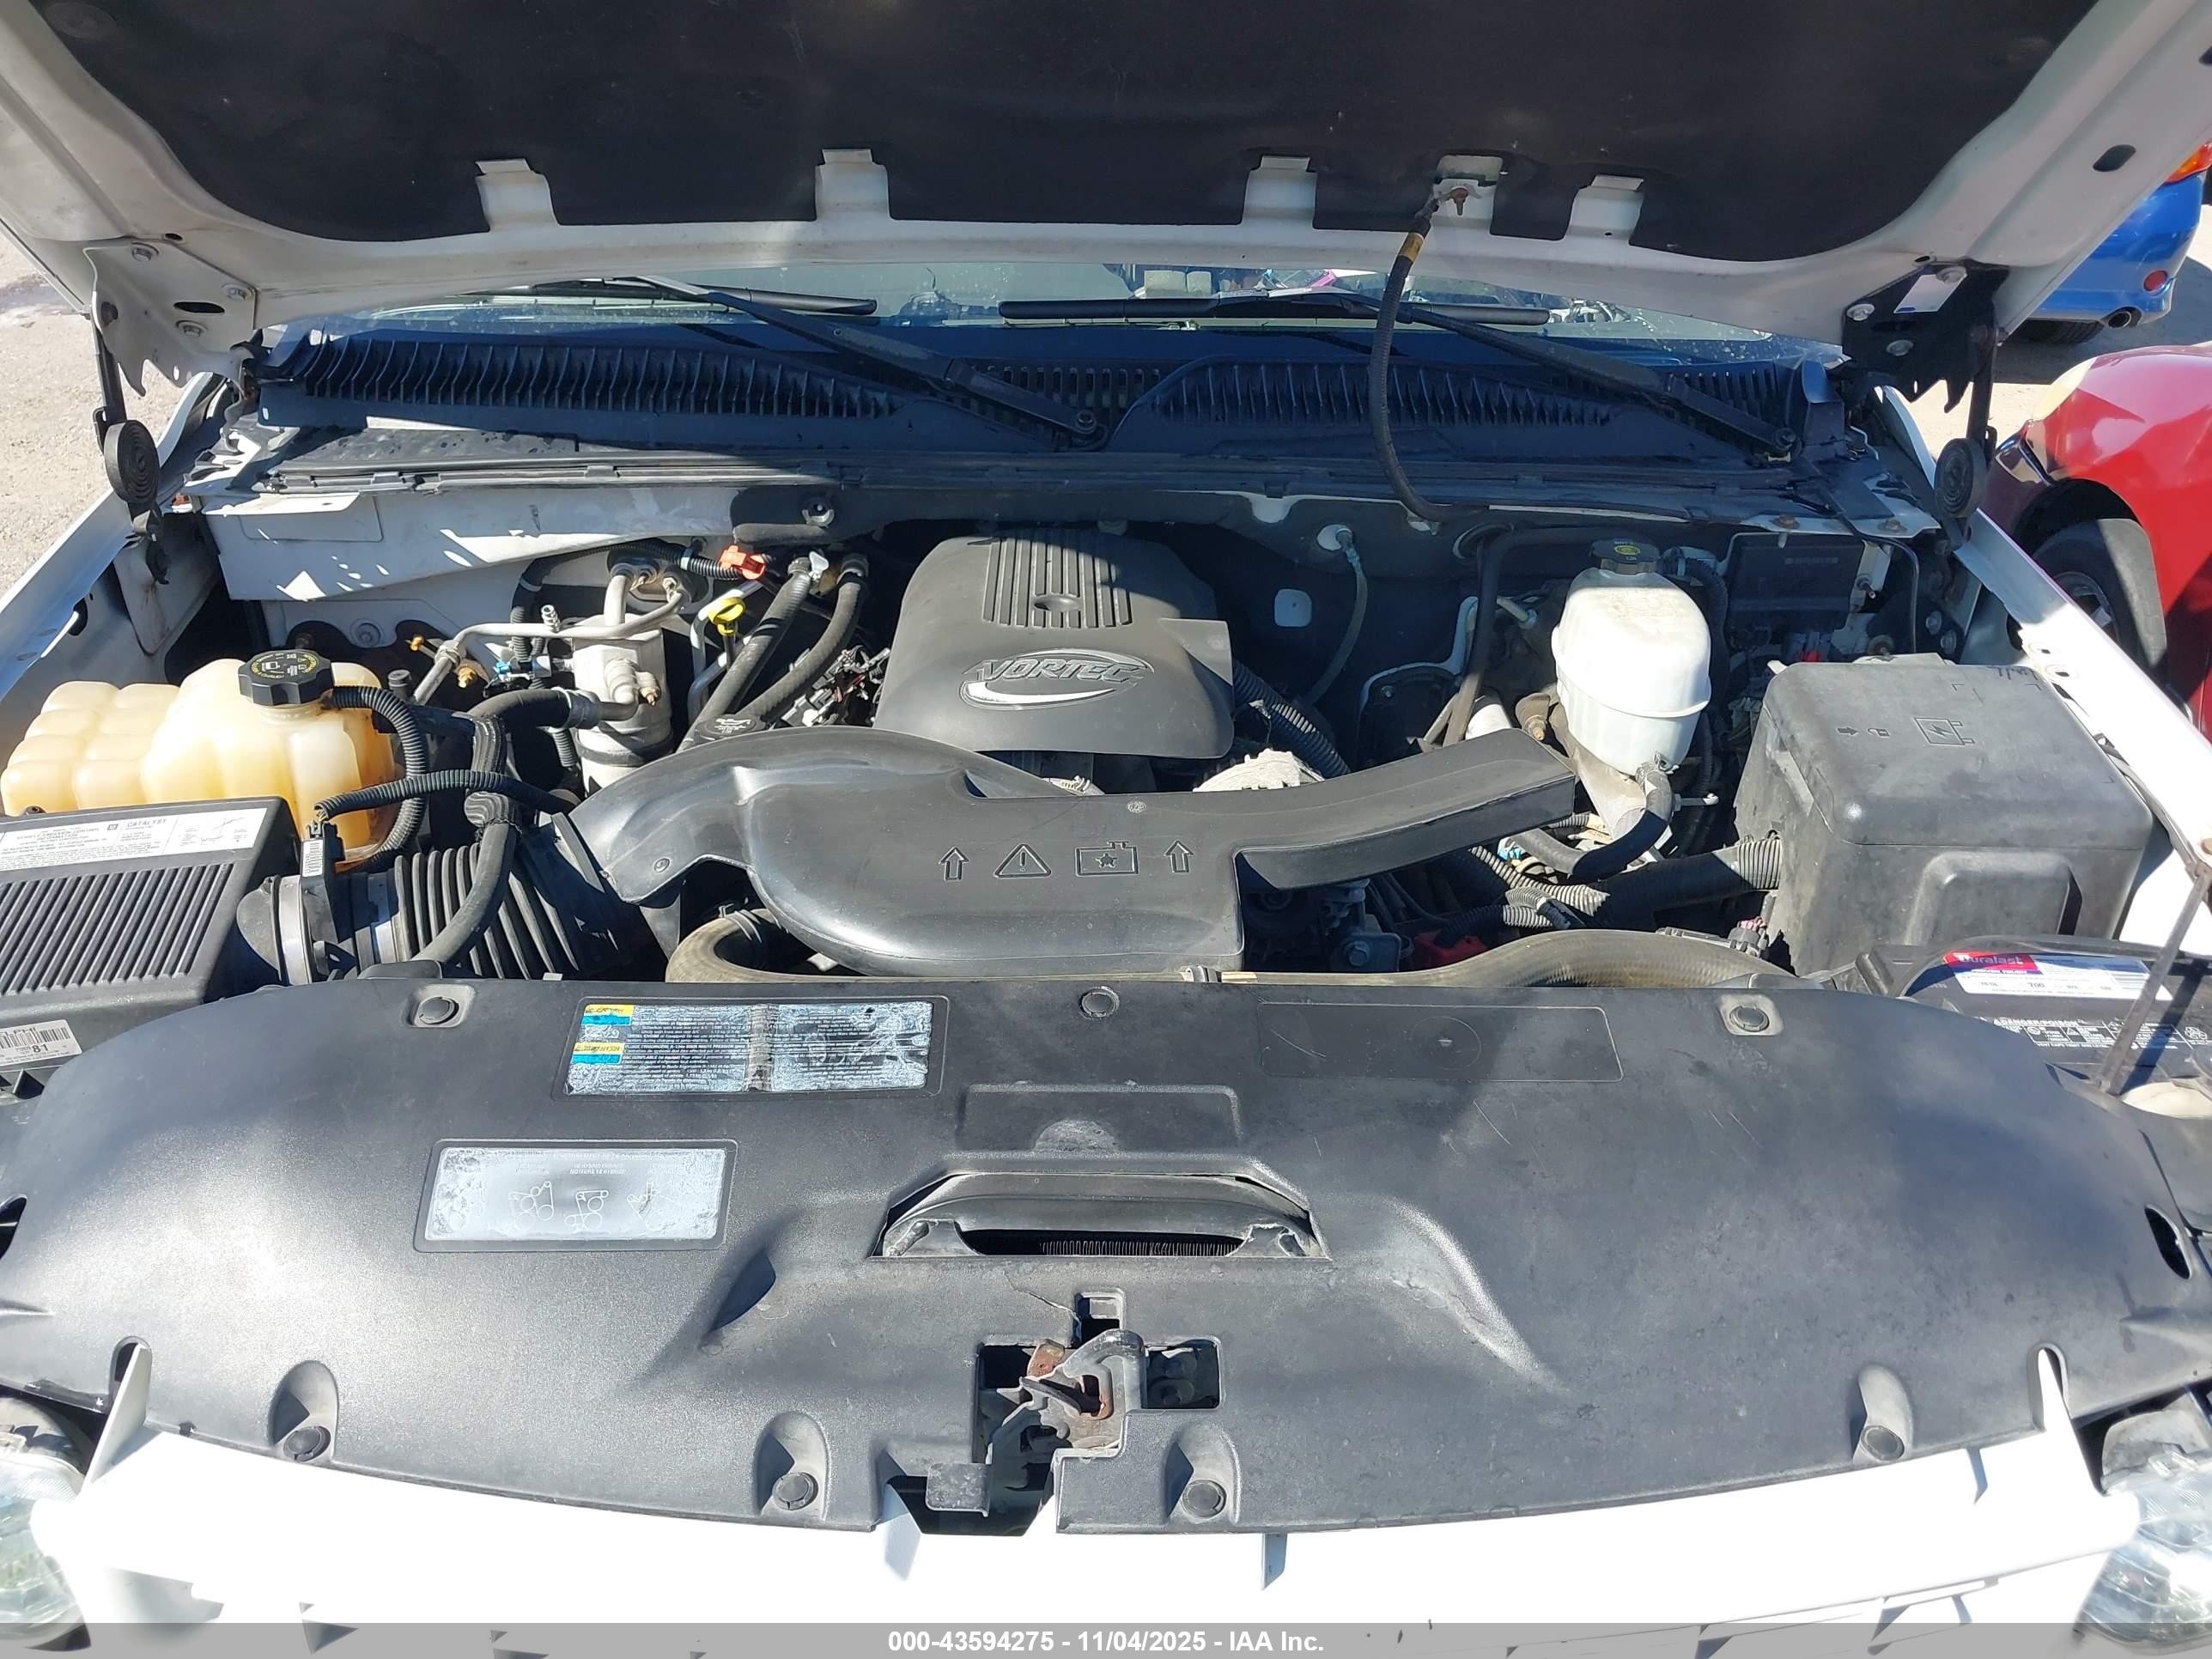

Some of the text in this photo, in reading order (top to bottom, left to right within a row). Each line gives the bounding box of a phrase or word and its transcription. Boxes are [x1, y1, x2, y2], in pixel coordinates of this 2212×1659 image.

[974, 658, 1142, 683] VORTEC
[126, 817, 167, 828] CATALYST
[1953, 952, 2024, 966] Duralast
[32, 1043, 49, 1054] 81
